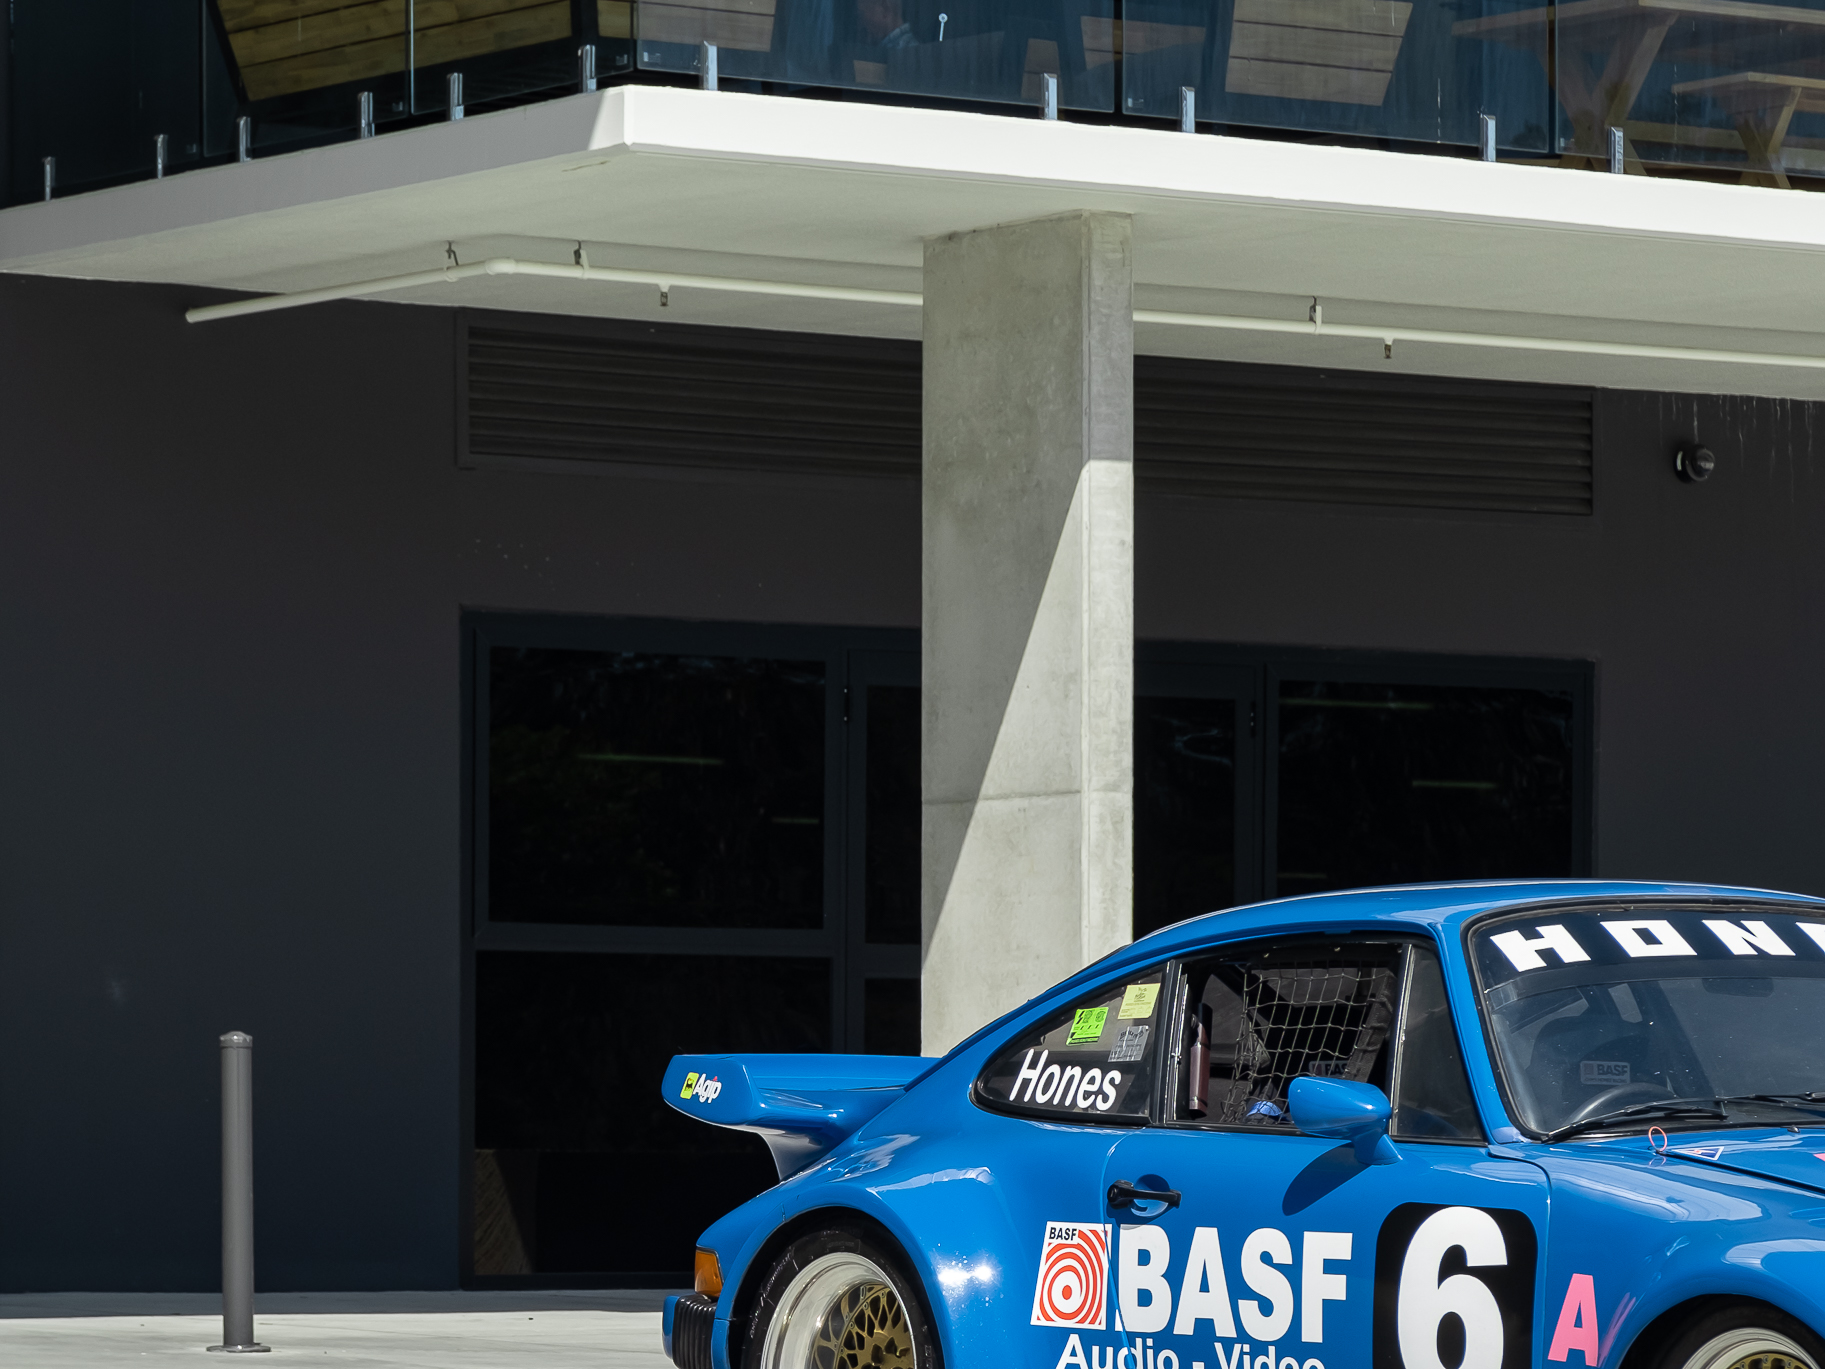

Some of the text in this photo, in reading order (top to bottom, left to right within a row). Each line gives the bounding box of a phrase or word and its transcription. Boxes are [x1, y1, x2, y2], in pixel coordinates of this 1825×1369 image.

[693, 1073, 722, 1103] Agip
[1009, 1048, 1122, 1111] Hones
[1597, 1063, 1628, 1077] BASF
[1049, 1226, 1078, 1241] BASF
[1114, 1223, 1353, 1343] BASF
[1547, 1273, 1599, 1368] A
